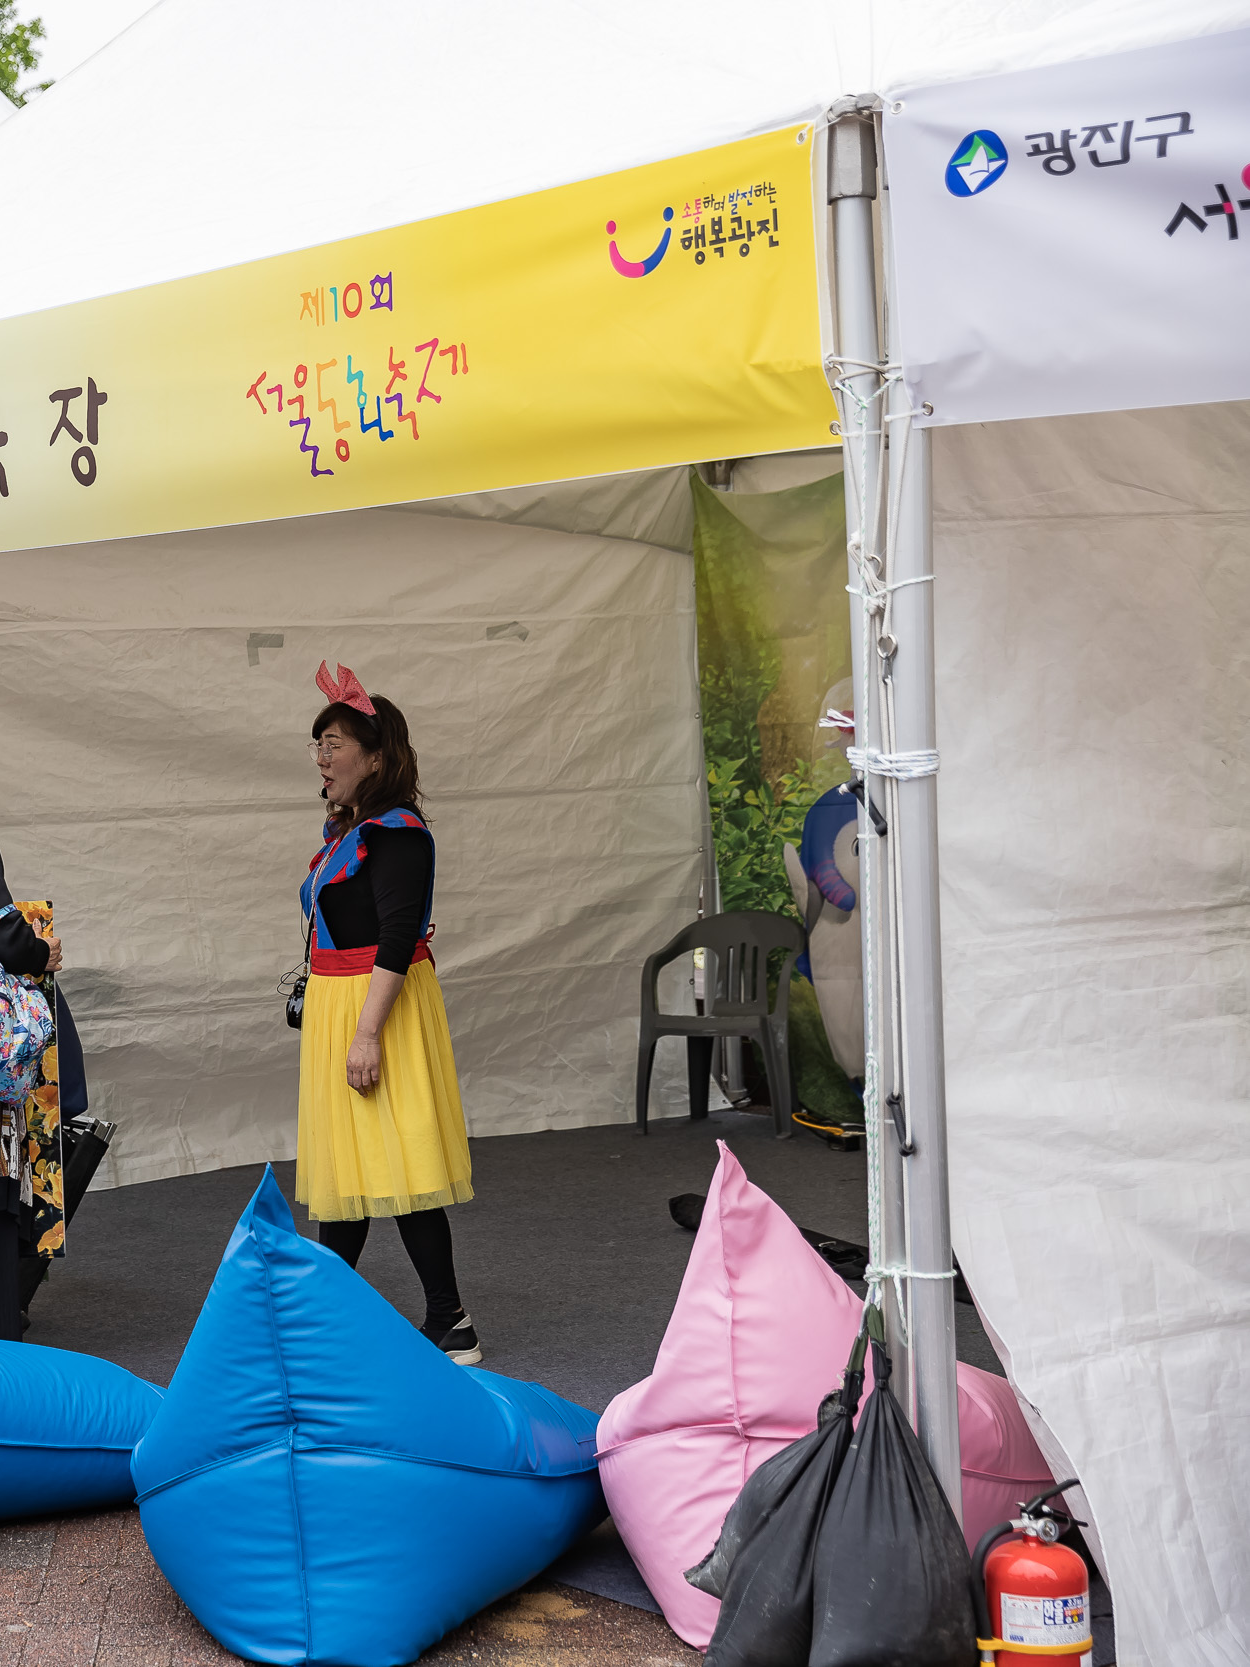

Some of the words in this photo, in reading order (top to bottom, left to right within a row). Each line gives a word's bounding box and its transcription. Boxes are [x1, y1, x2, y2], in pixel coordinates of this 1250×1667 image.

[1025, 111, 1194, 176] 광진구
[681, 194, 726, 224] 소통하며
[727, 182, 777, 216] 발전하는
[680, 208, 780, 265] 행복광진
[299, 271, 394, 326] 제10회
